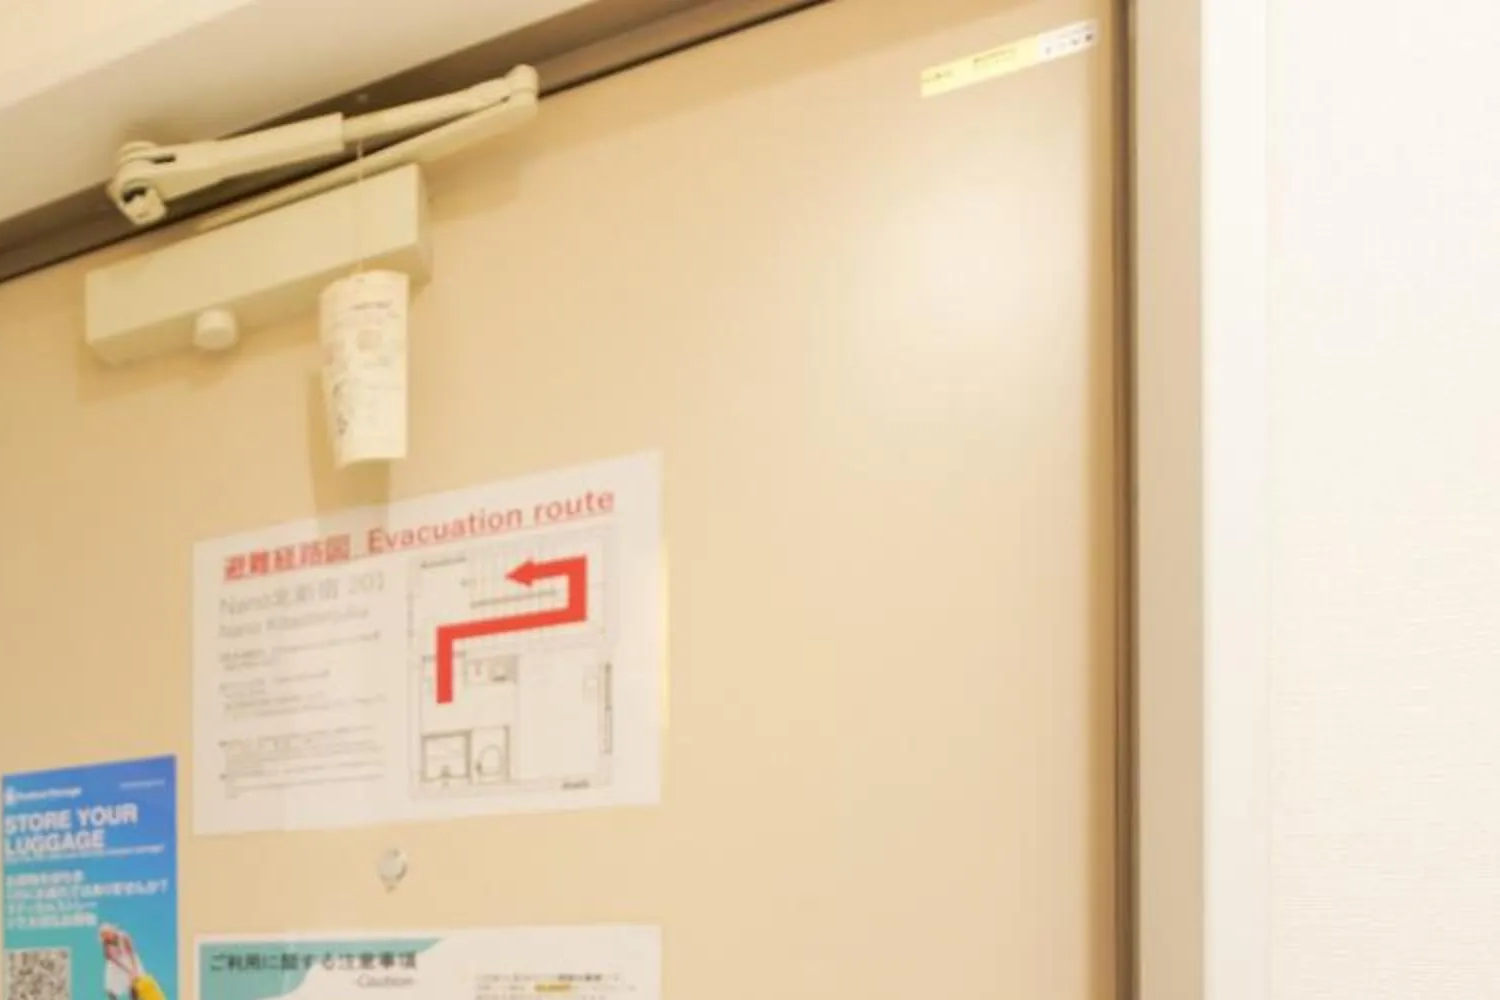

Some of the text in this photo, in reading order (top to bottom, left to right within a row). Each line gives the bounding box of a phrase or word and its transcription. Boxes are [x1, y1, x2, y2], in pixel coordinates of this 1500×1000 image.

[367, 508, 523, 553] Evacuation
[534, 490, 615, 525] route
[4, 802, 139, 835] STORE YOUR
[4, 829, 106, 856] LUGGAGE
[210, 951, 418, 972] ご利用に関する注意事項
